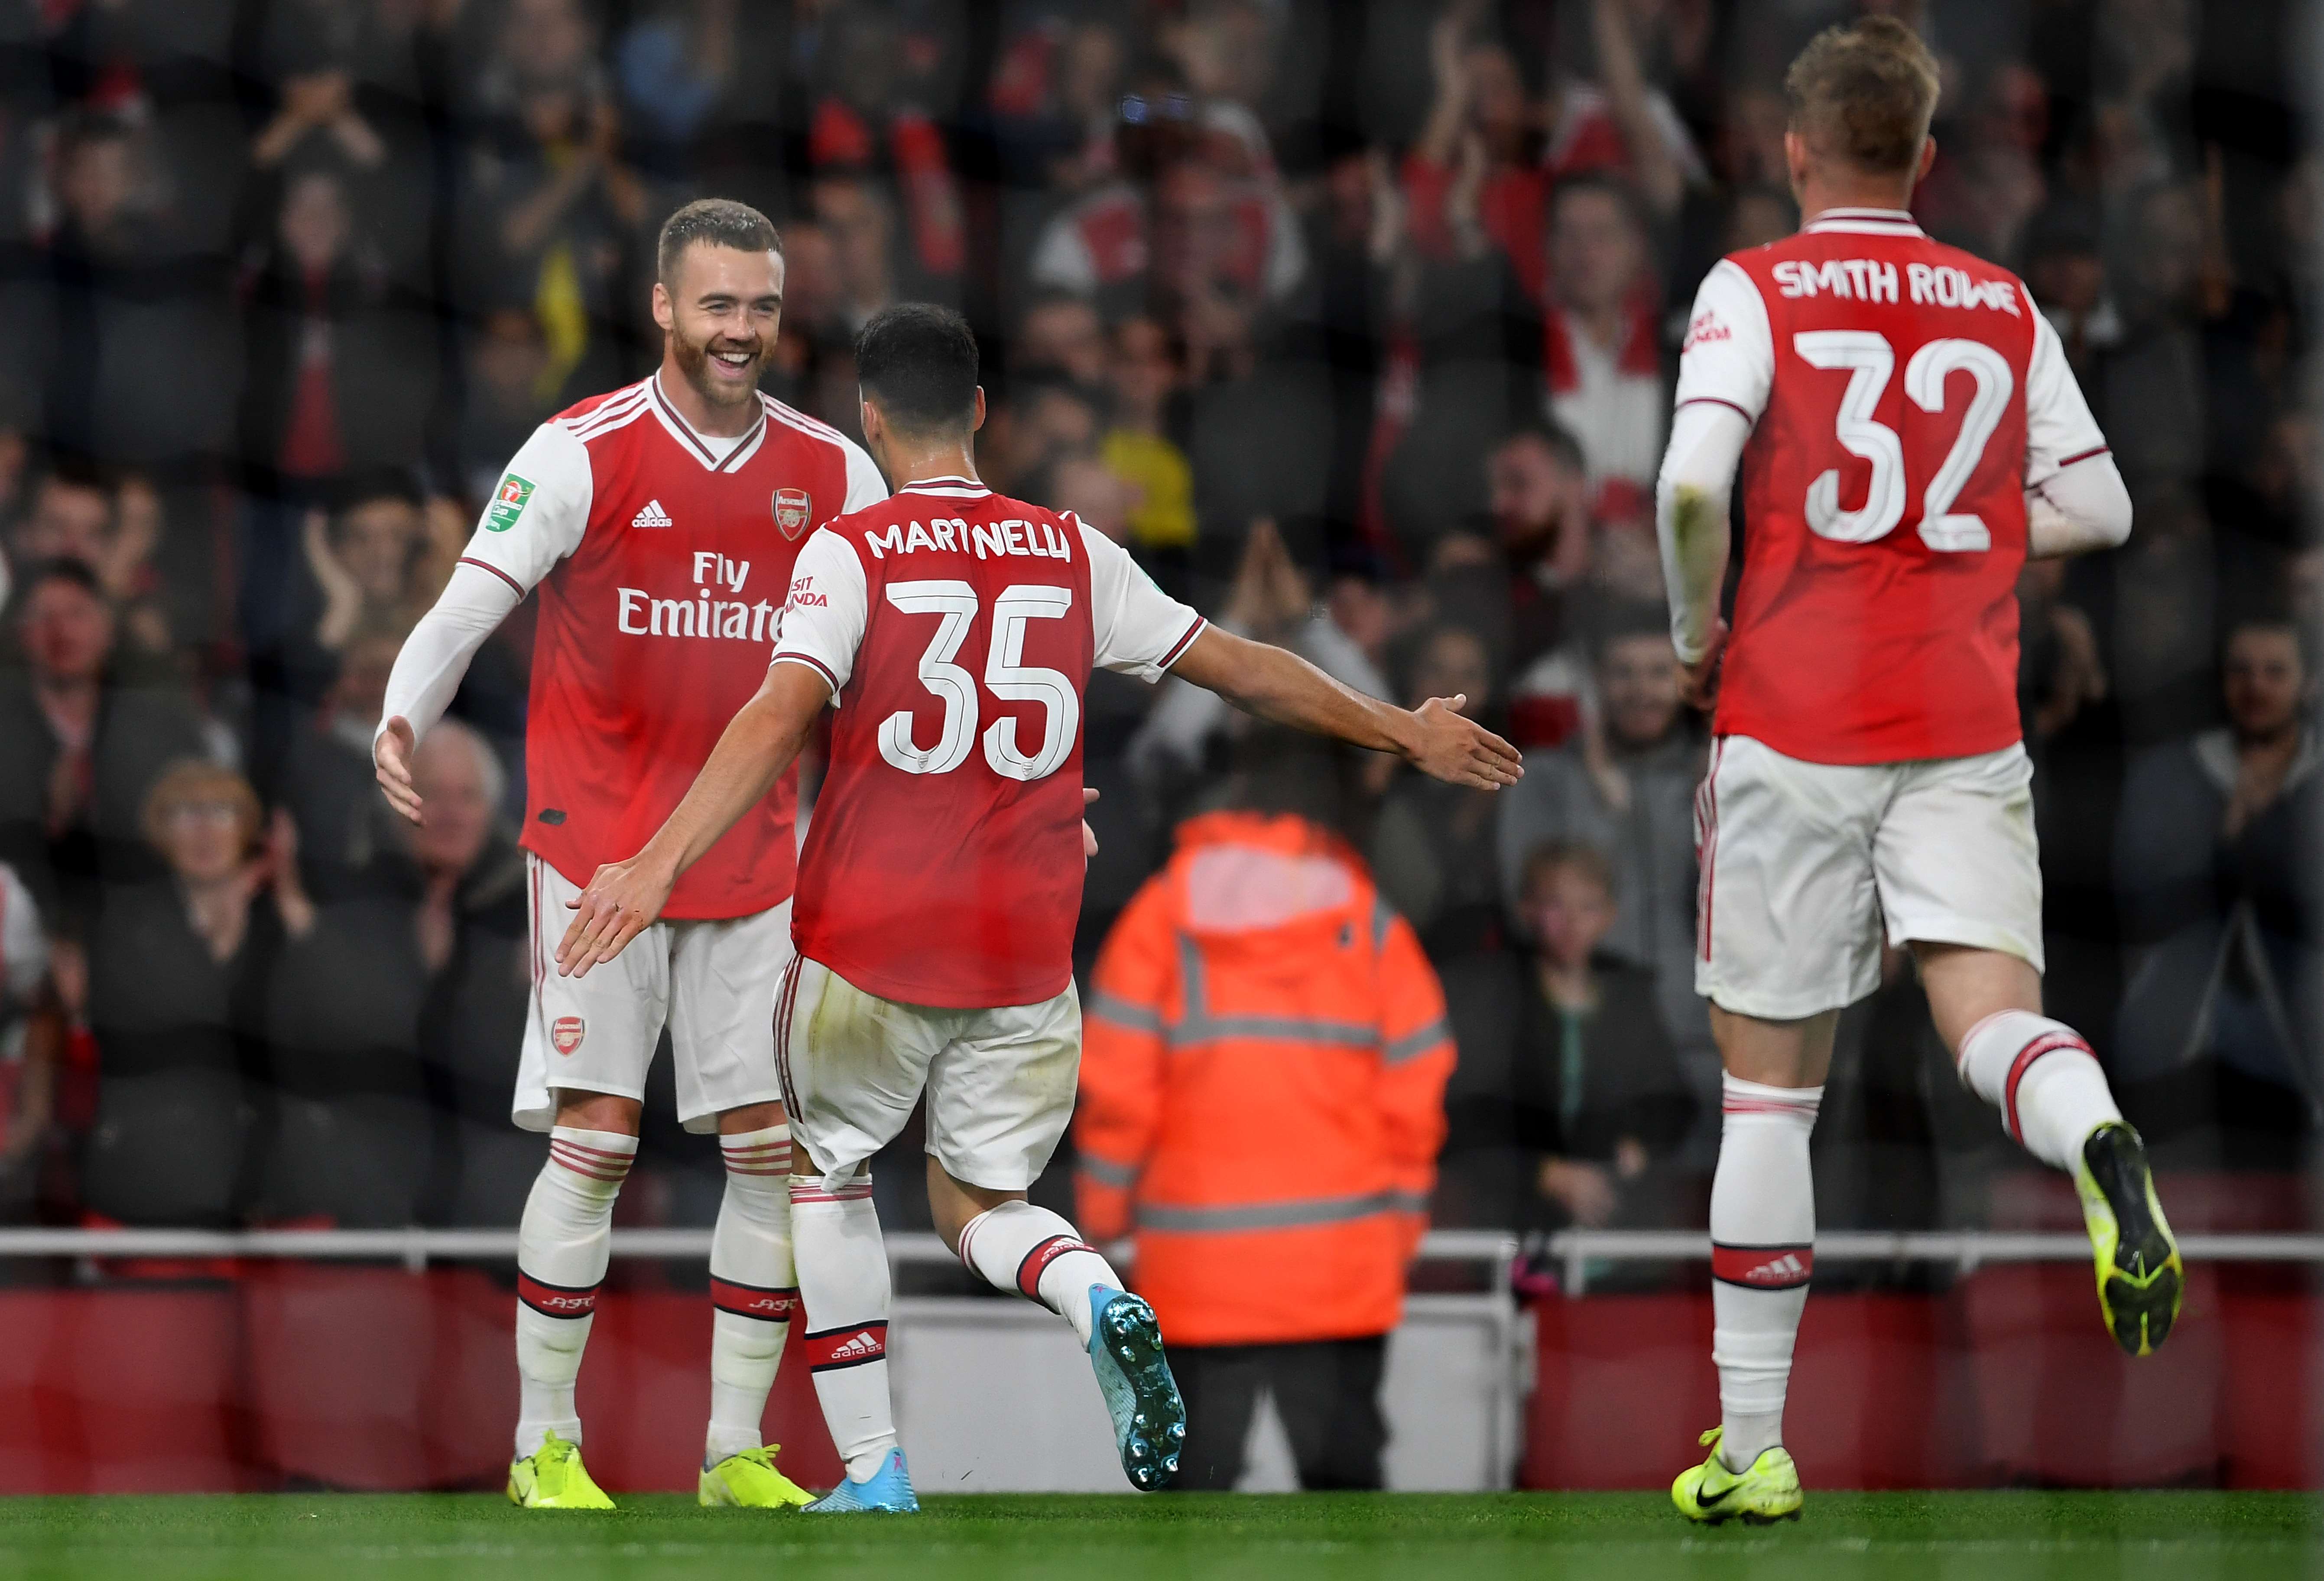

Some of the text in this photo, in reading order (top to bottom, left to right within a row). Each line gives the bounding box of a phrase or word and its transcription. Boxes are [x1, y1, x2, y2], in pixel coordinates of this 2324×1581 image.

[1772, 259, 2022, 320] SMITH ROWE
[1792, 329, 2015, 553] 32
[632, 517, 672, 527] adidas
[693, 551, 750, 593] Fly
[877, 579, 1080, 782] 35
[831, 1344, 883, 1359] adidas
